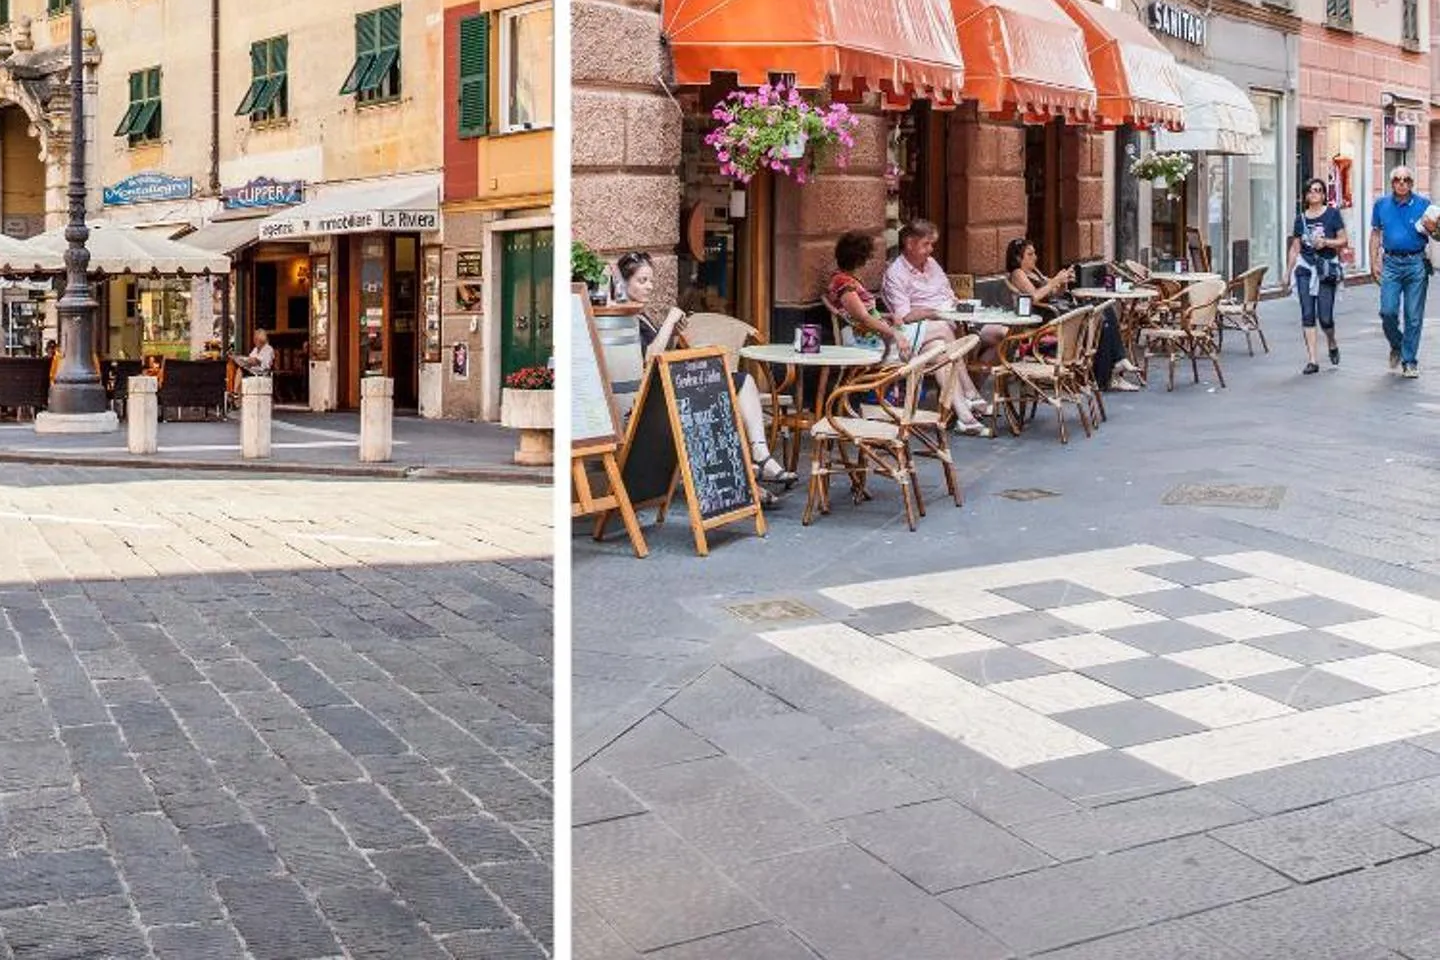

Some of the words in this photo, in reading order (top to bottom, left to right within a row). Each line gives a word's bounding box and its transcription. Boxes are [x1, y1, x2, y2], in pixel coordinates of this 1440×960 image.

[1154, 1, 1207, 48] SANITARI
[381, 212, 395, 227] La
[398, 212, 436, 228] Riviera
